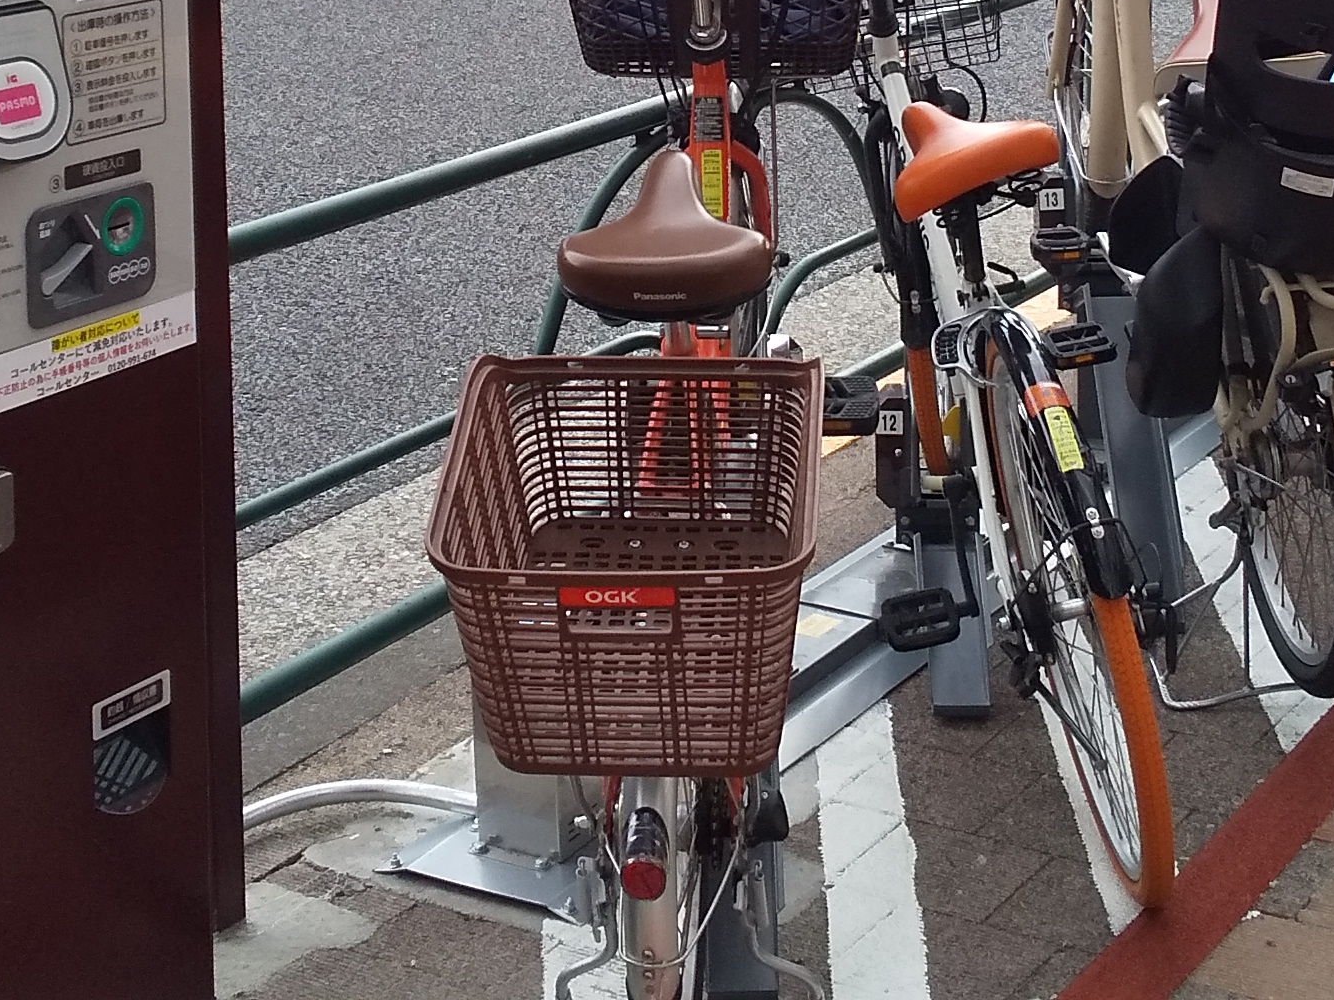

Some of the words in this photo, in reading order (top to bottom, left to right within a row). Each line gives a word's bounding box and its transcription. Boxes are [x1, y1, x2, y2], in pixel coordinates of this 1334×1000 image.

[0, 95, 36, 113] PASMO
[1044, 189, 1059, 208] 13
[633, 291, 687, 301] Panasonic
[36, 370, 100, 397] コールセンター
[107, 349, 157, 373] 0120-991-674
[881, 413, 897, 432] 12
[584, 589, 638, 604] OGK
